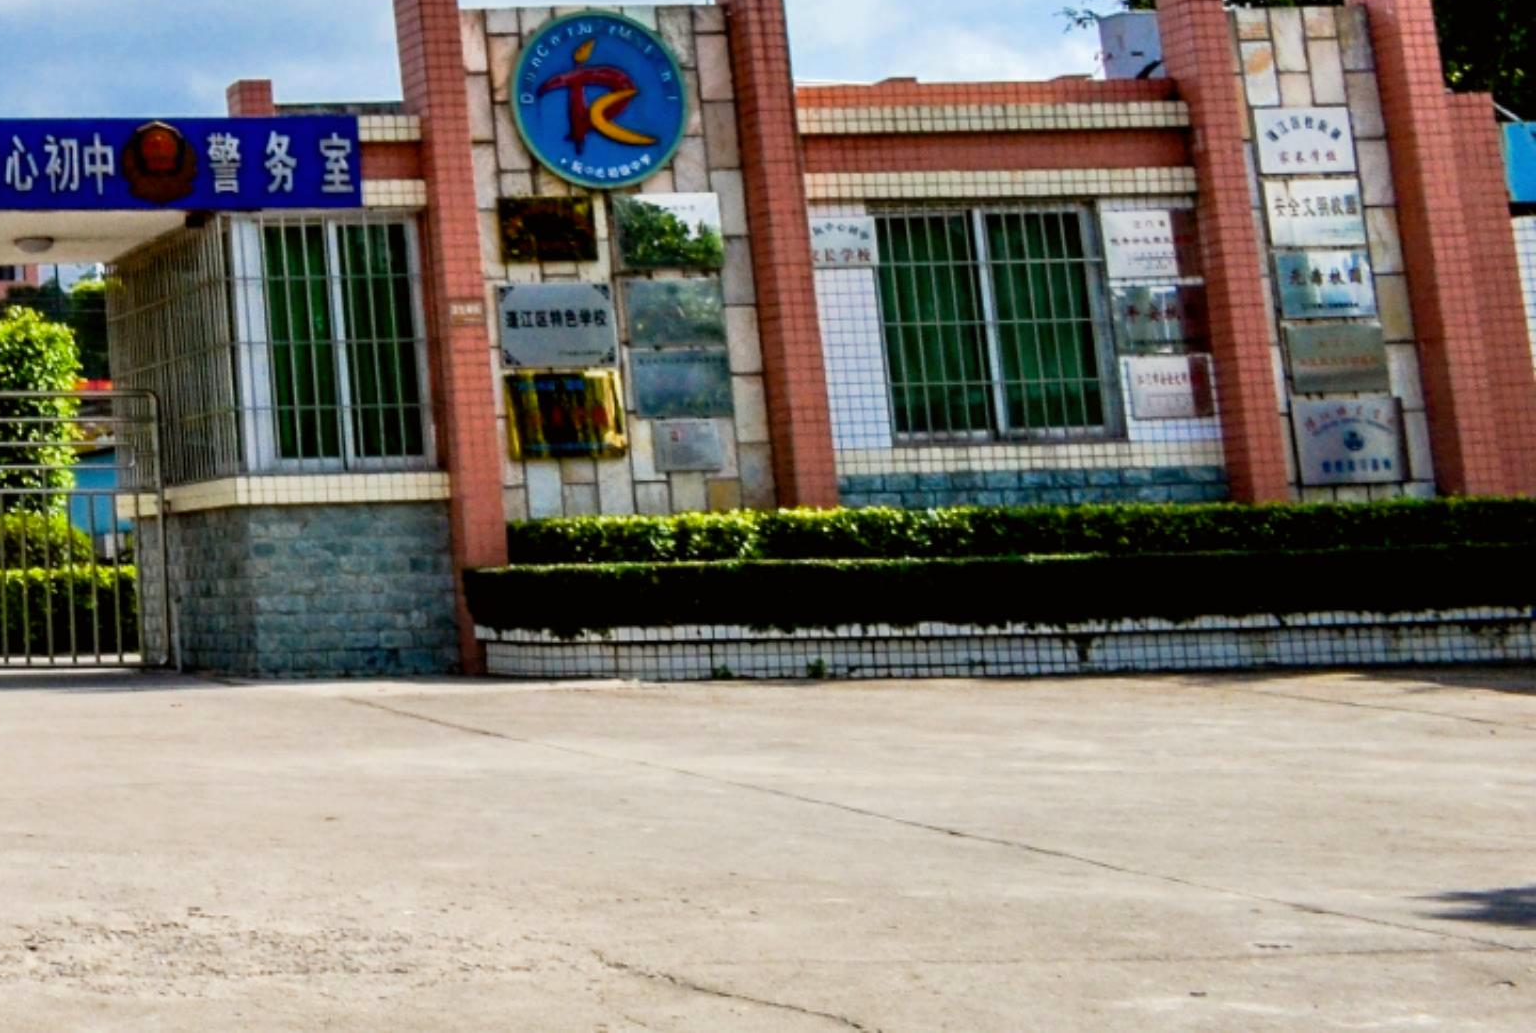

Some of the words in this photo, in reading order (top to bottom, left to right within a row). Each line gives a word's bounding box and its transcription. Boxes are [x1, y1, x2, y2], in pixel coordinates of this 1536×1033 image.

[207, 130, 354, 193] 警务室
[1274, 194, 1358, 217] 安全文明校园
[506, 309, 608, 329] 蓬江区特色学校
